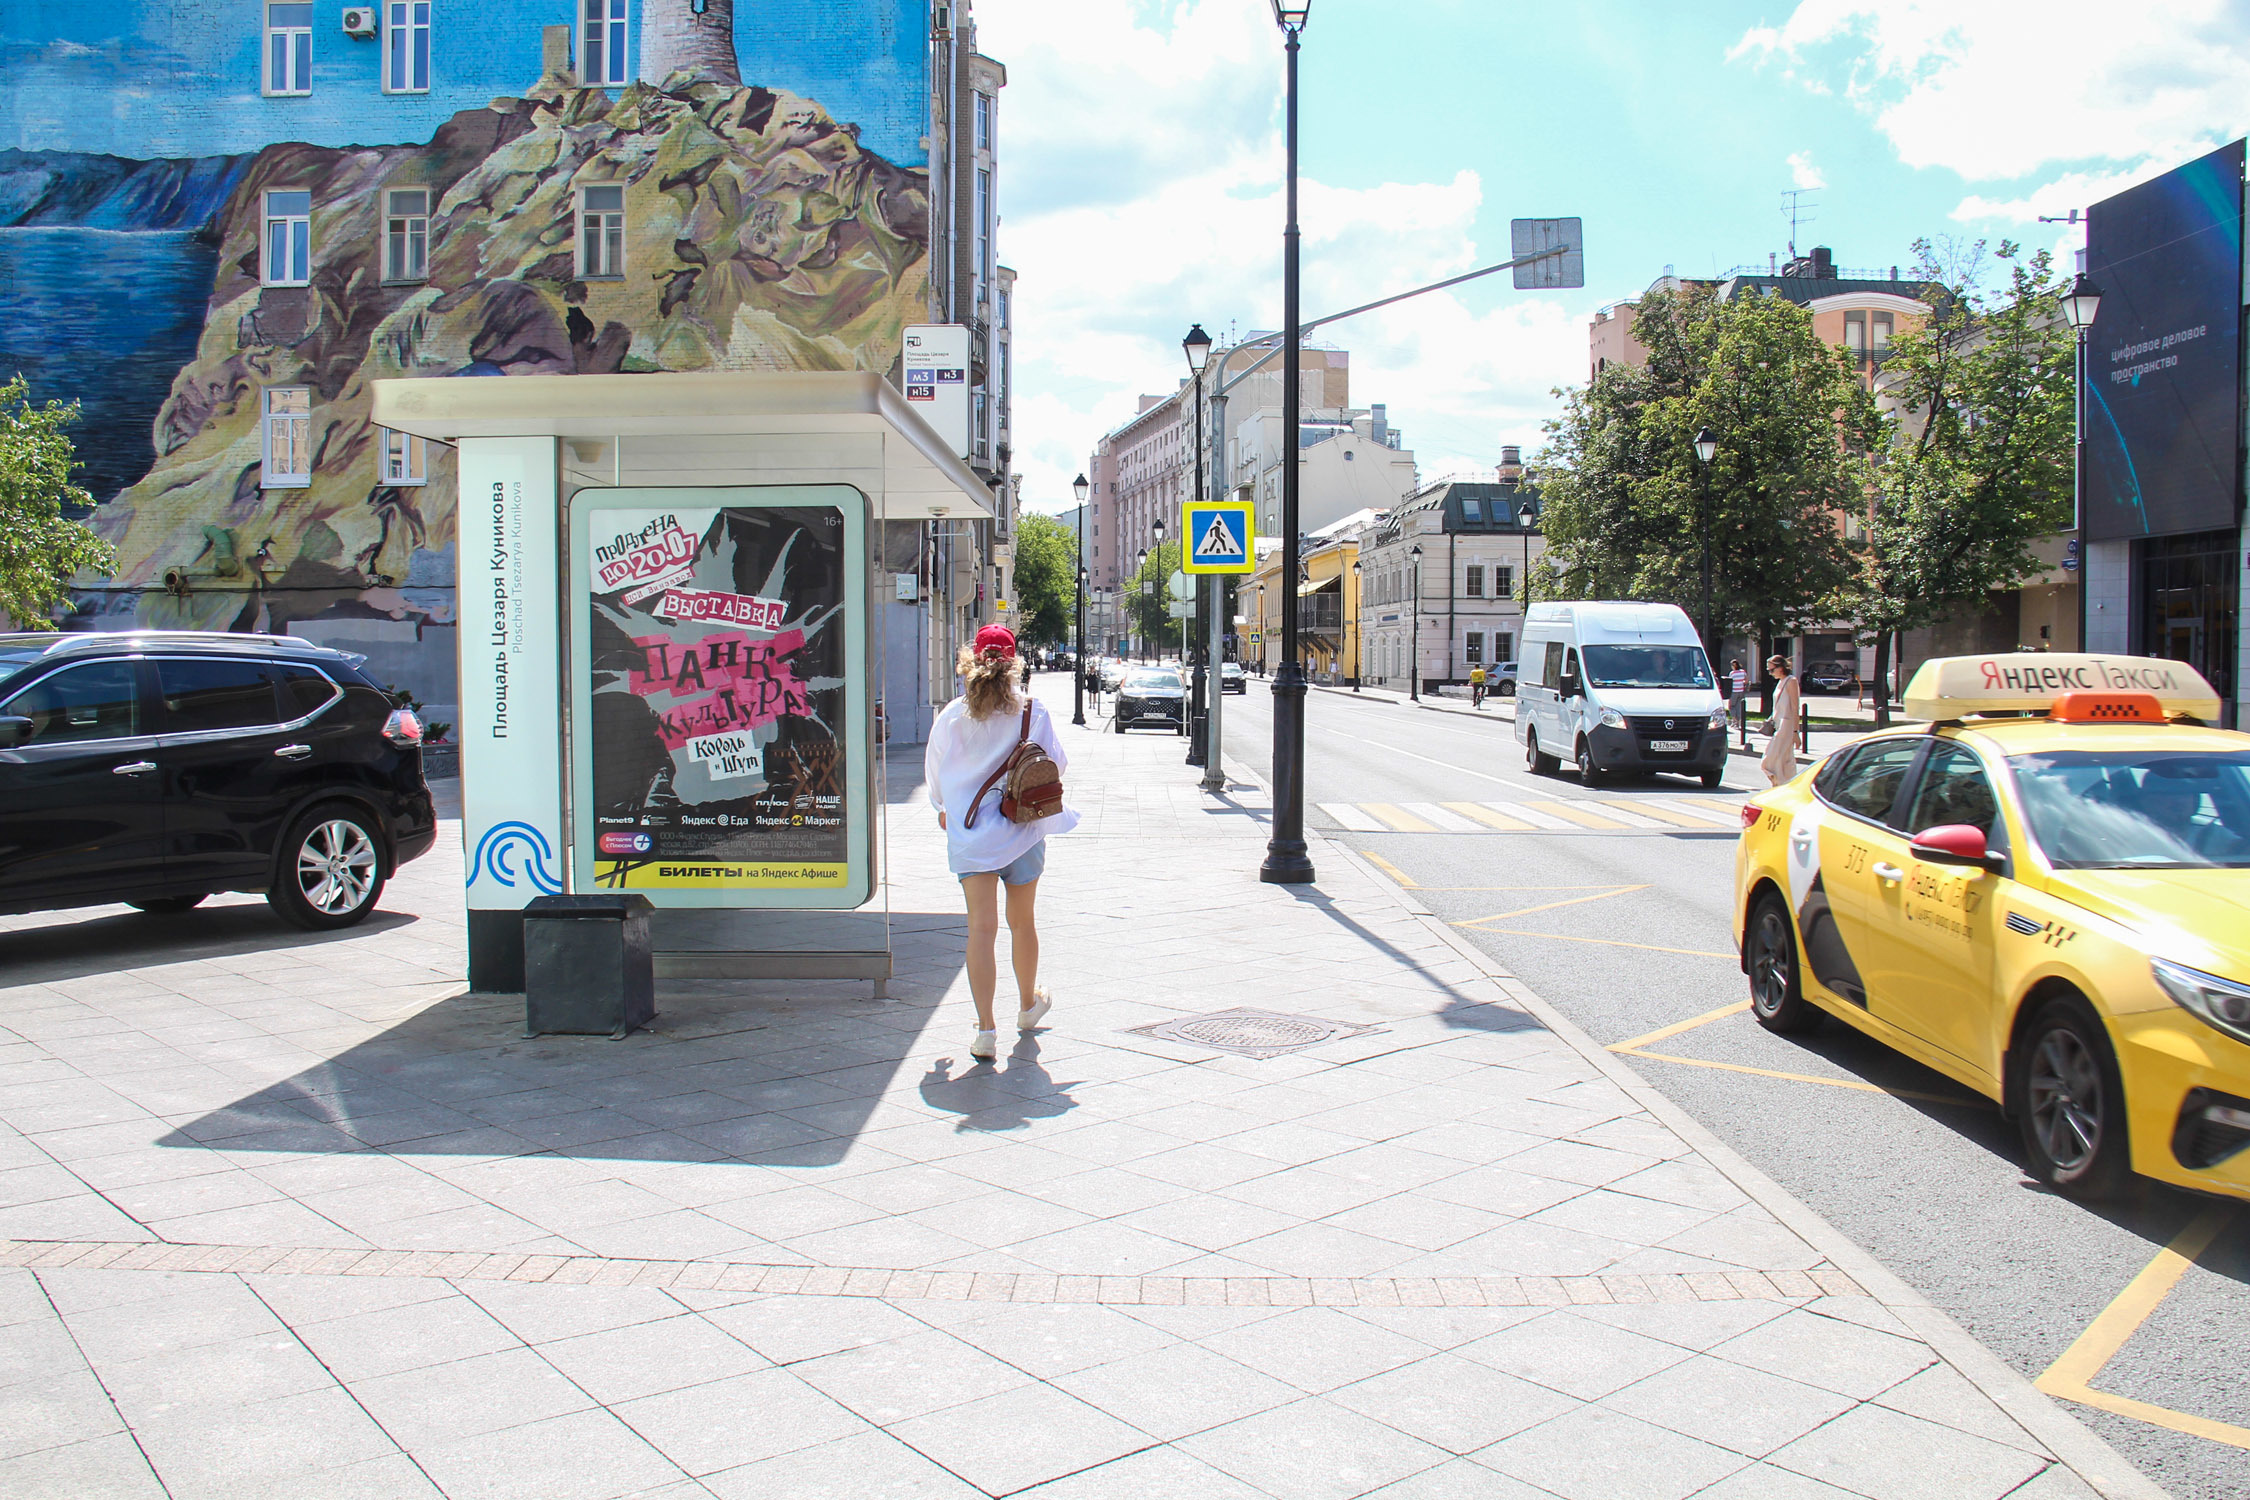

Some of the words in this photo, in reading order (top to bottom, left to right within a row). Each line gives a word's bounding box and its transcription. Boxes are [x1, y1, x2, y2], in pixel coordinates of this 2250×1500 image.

[2111, 338, 2160, 363] цифровое
[2161, 325, 2206, 350] деловое
[2111, 355, 2178, 384] пространство
[490, 481, 508, 570] Куникова
[511, 481, 522, 538] Kunikova
[823, 516, 842, 526] 16+
[512, 542, 523, 595] Tsezarya
[630, 531, 695, 577] 20.07
[647, 571, 692, 593] Винзавод
[491, 577, 508, 646] Цезаря
[512, 598, 524, 654] Ploschad
[664, 595, 780, 627] ВЫСТАВКА
[1980, 660, 2094, 693] Яндекс
[2089, 660, 2179, 690] Такси
[493, 652, 508, 739] Площадь
[721, 755, 759, 773] Шут
[815, 795, 841, 804] НАШЕ
[681, 815, 716, 826] Яндекс
[731, 816, 749, 826] Еда
[755, 815, 790, 826] Яндекс
[805, 816, 841, 826] Маркет
[659, 867, 743, 877] БИЛЕТЫ
[746, 869, 759, 877] на
[761, 867, 799, 878] Яндекс
[801, 868, 838, 879] Афише
